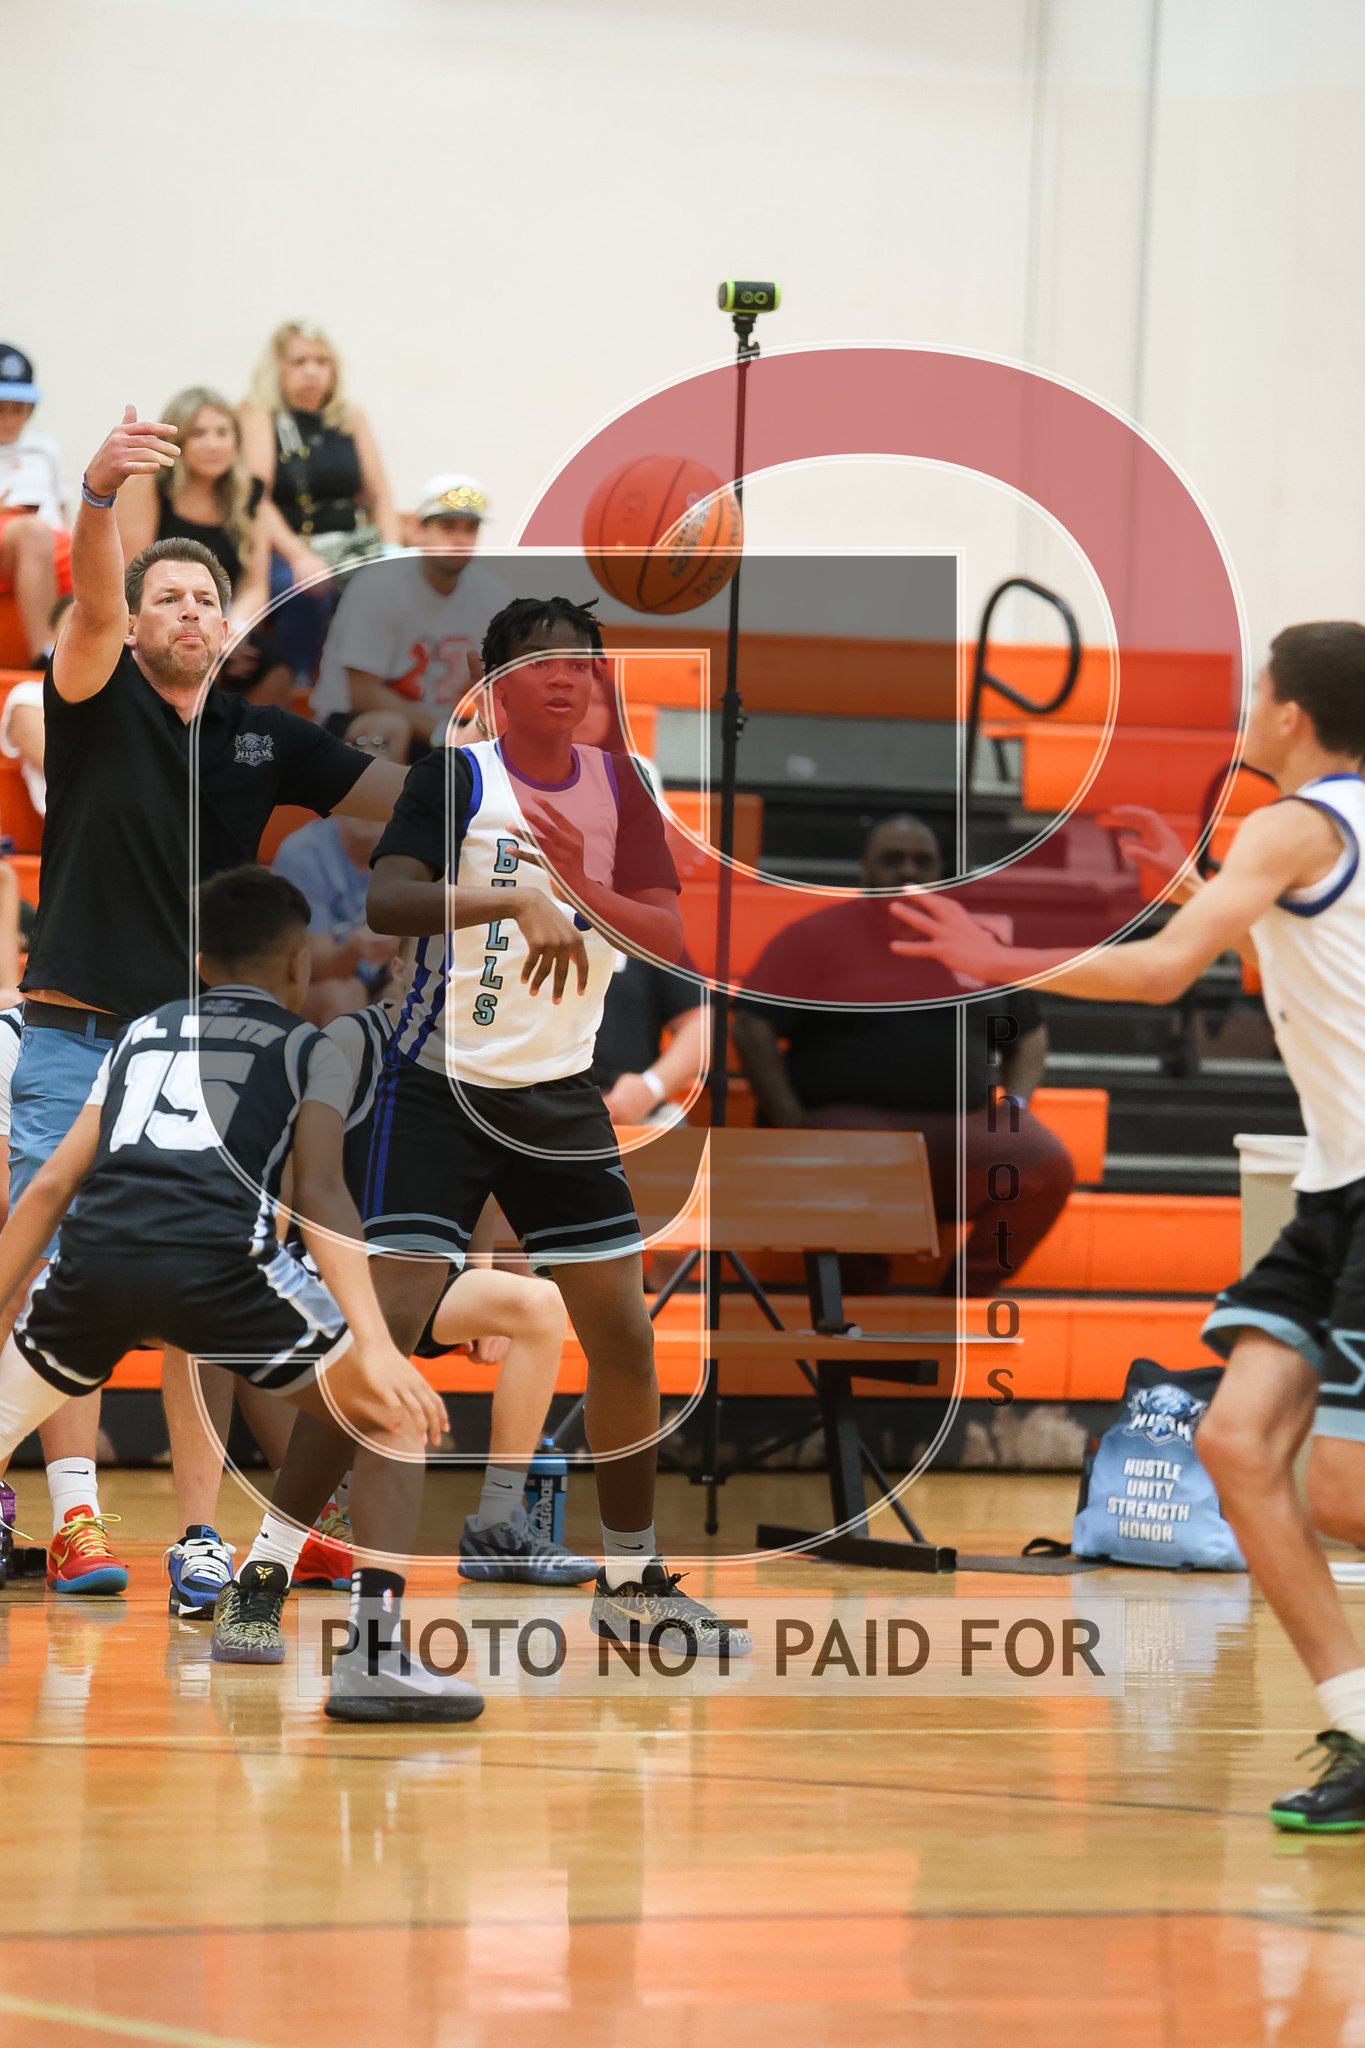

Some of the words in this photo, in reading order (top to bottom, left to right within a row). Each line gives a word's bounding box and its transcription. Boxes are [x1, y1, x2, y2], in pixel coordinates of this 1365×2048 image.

[472, 838, 519, 1026] BLLS
[109, 1049, 256, 1153] 15
[1123, 1457, 1183, 1481] HUSTLE
[1126, 1480, 1175, 1500] UNITY
[1106, 1496, 1189, 1521] STRENGTH
[1119, 1519, 1173, 1542] HONOR
